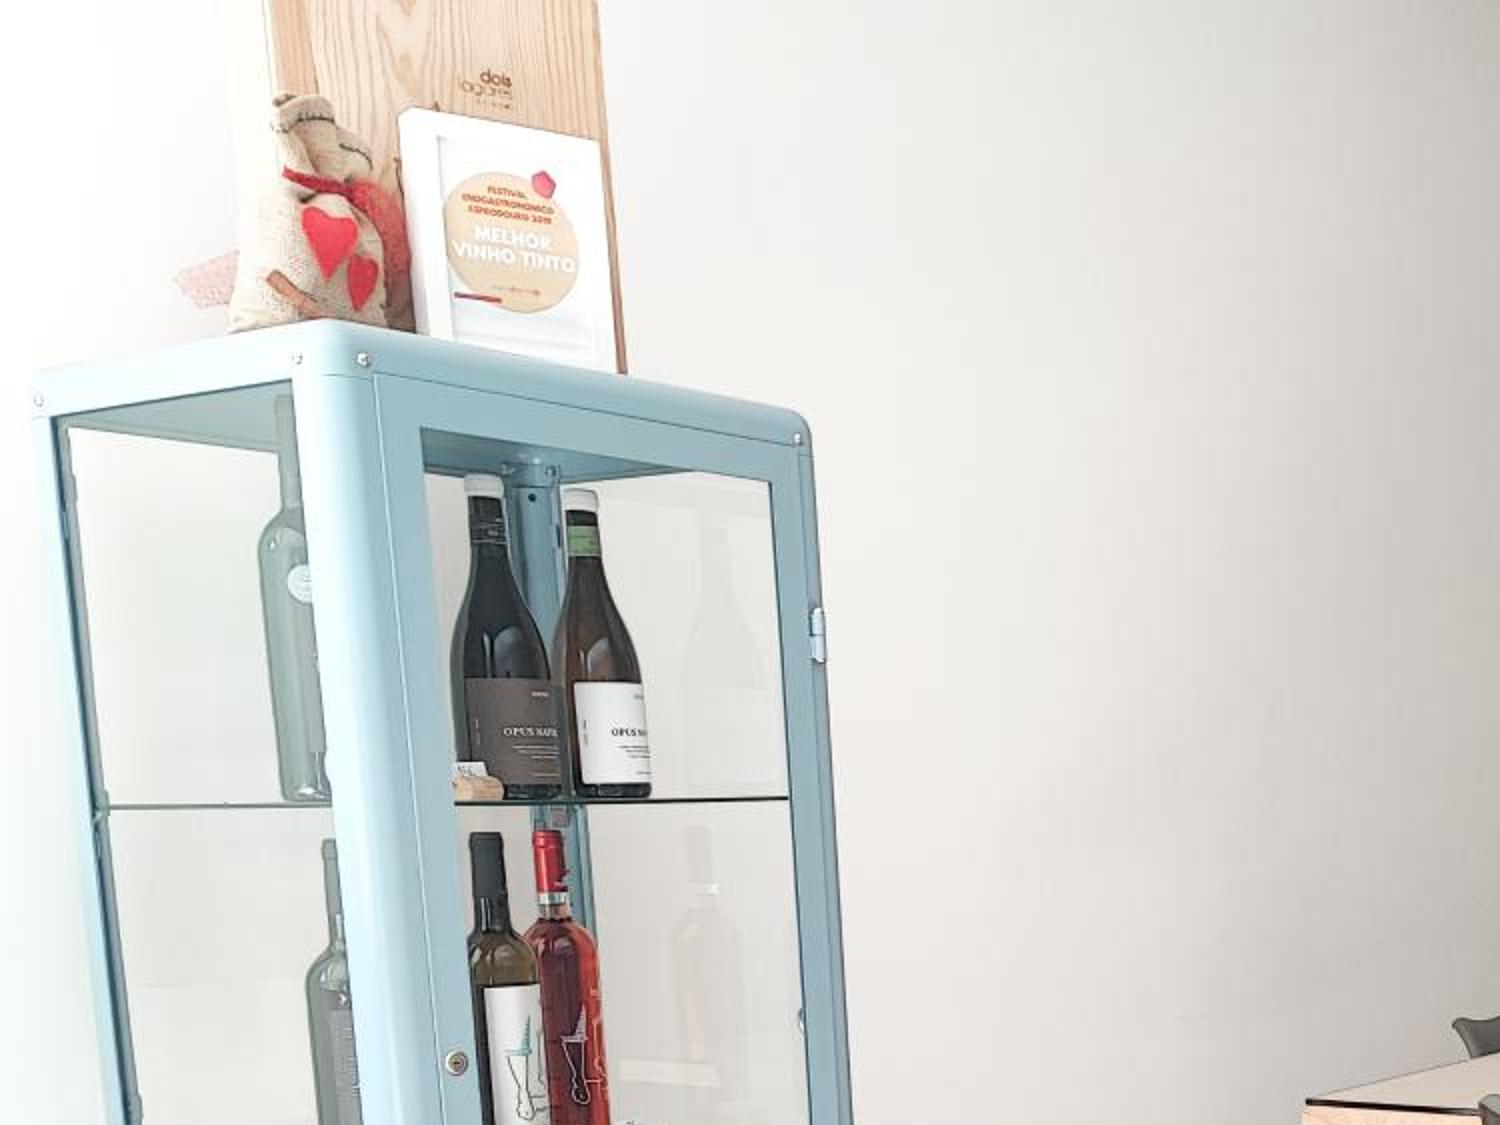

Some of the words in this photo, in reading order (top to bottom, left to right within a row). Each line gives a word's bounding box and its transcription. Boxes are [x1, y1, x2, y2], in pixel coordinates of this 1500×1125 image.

[475, 224, 551, 249] MELHOR
[452, 240, 515, 264] VINHO
[523, 252, 576, 273] TINTO
[503, 726, 534, 738] OPUS
